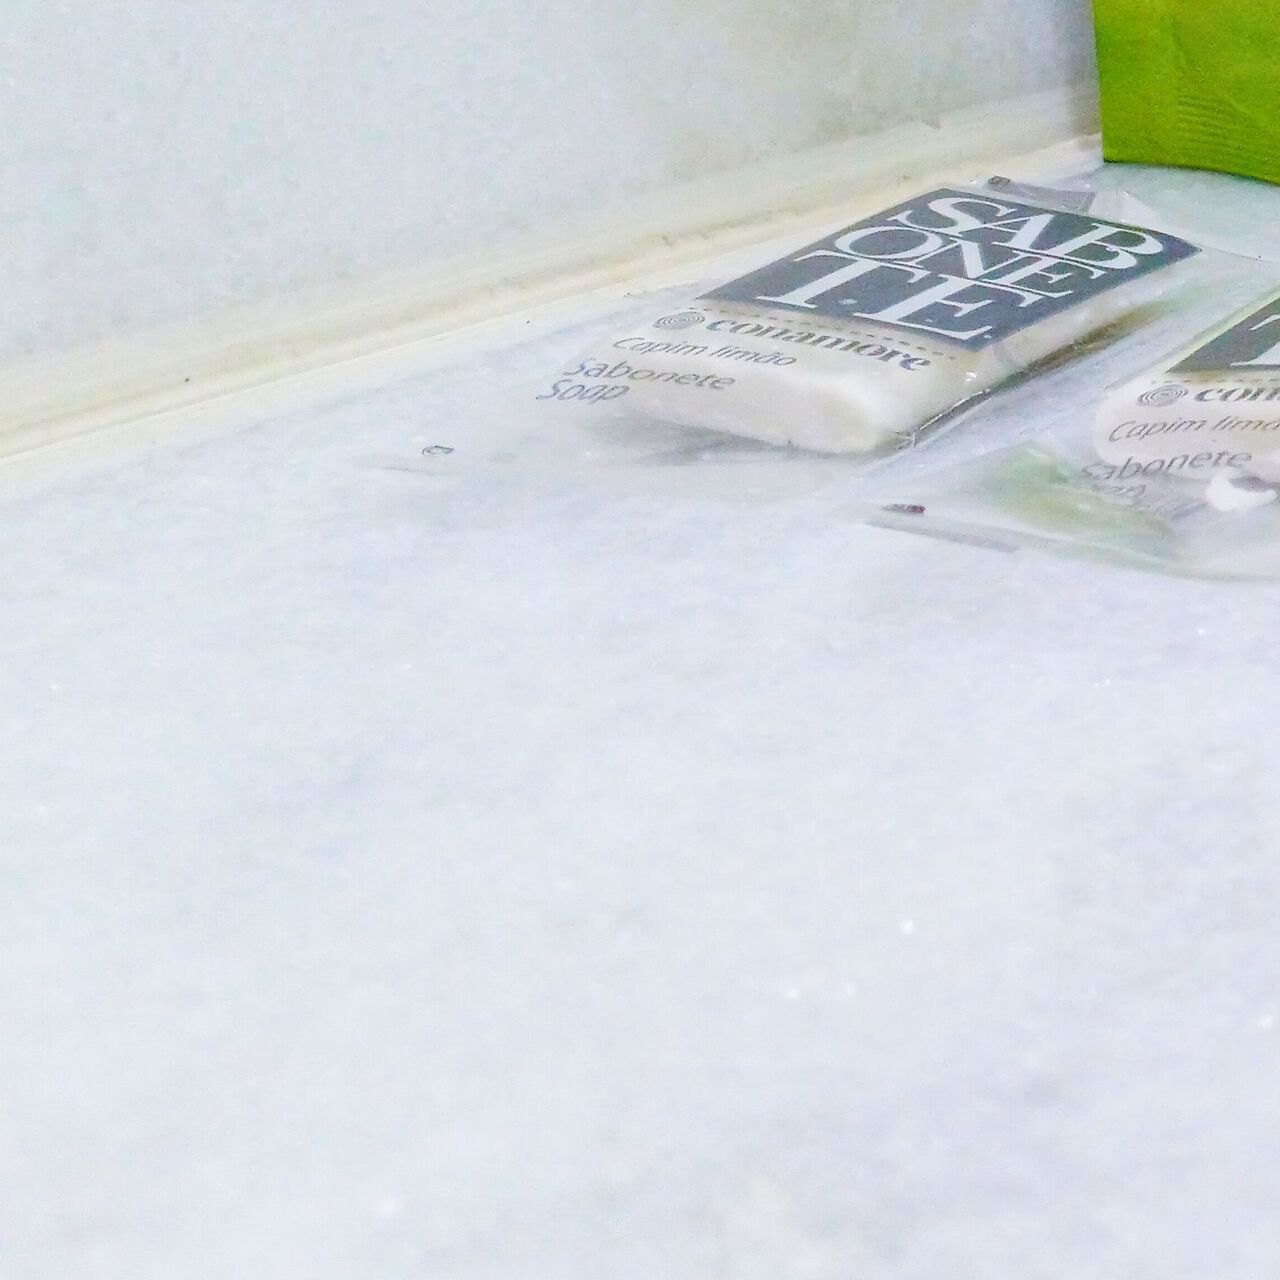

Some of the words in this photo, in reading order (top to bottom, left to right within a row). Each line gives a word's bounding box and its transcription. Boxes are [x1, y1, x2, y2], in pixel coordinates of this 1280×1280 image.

[886, 197, 1163, 269] SAB
[834, 226, 1106, 298] ONE
[757, 249, 1043, 341] TE
[613, 336, 706, 357] Capim
[705, 318, 932, 372] conamore
[536, 379, 630, 405] Soap
[563, 358, 736, 390] Sabonete
[1109, 416, 1207, 442] Capim
